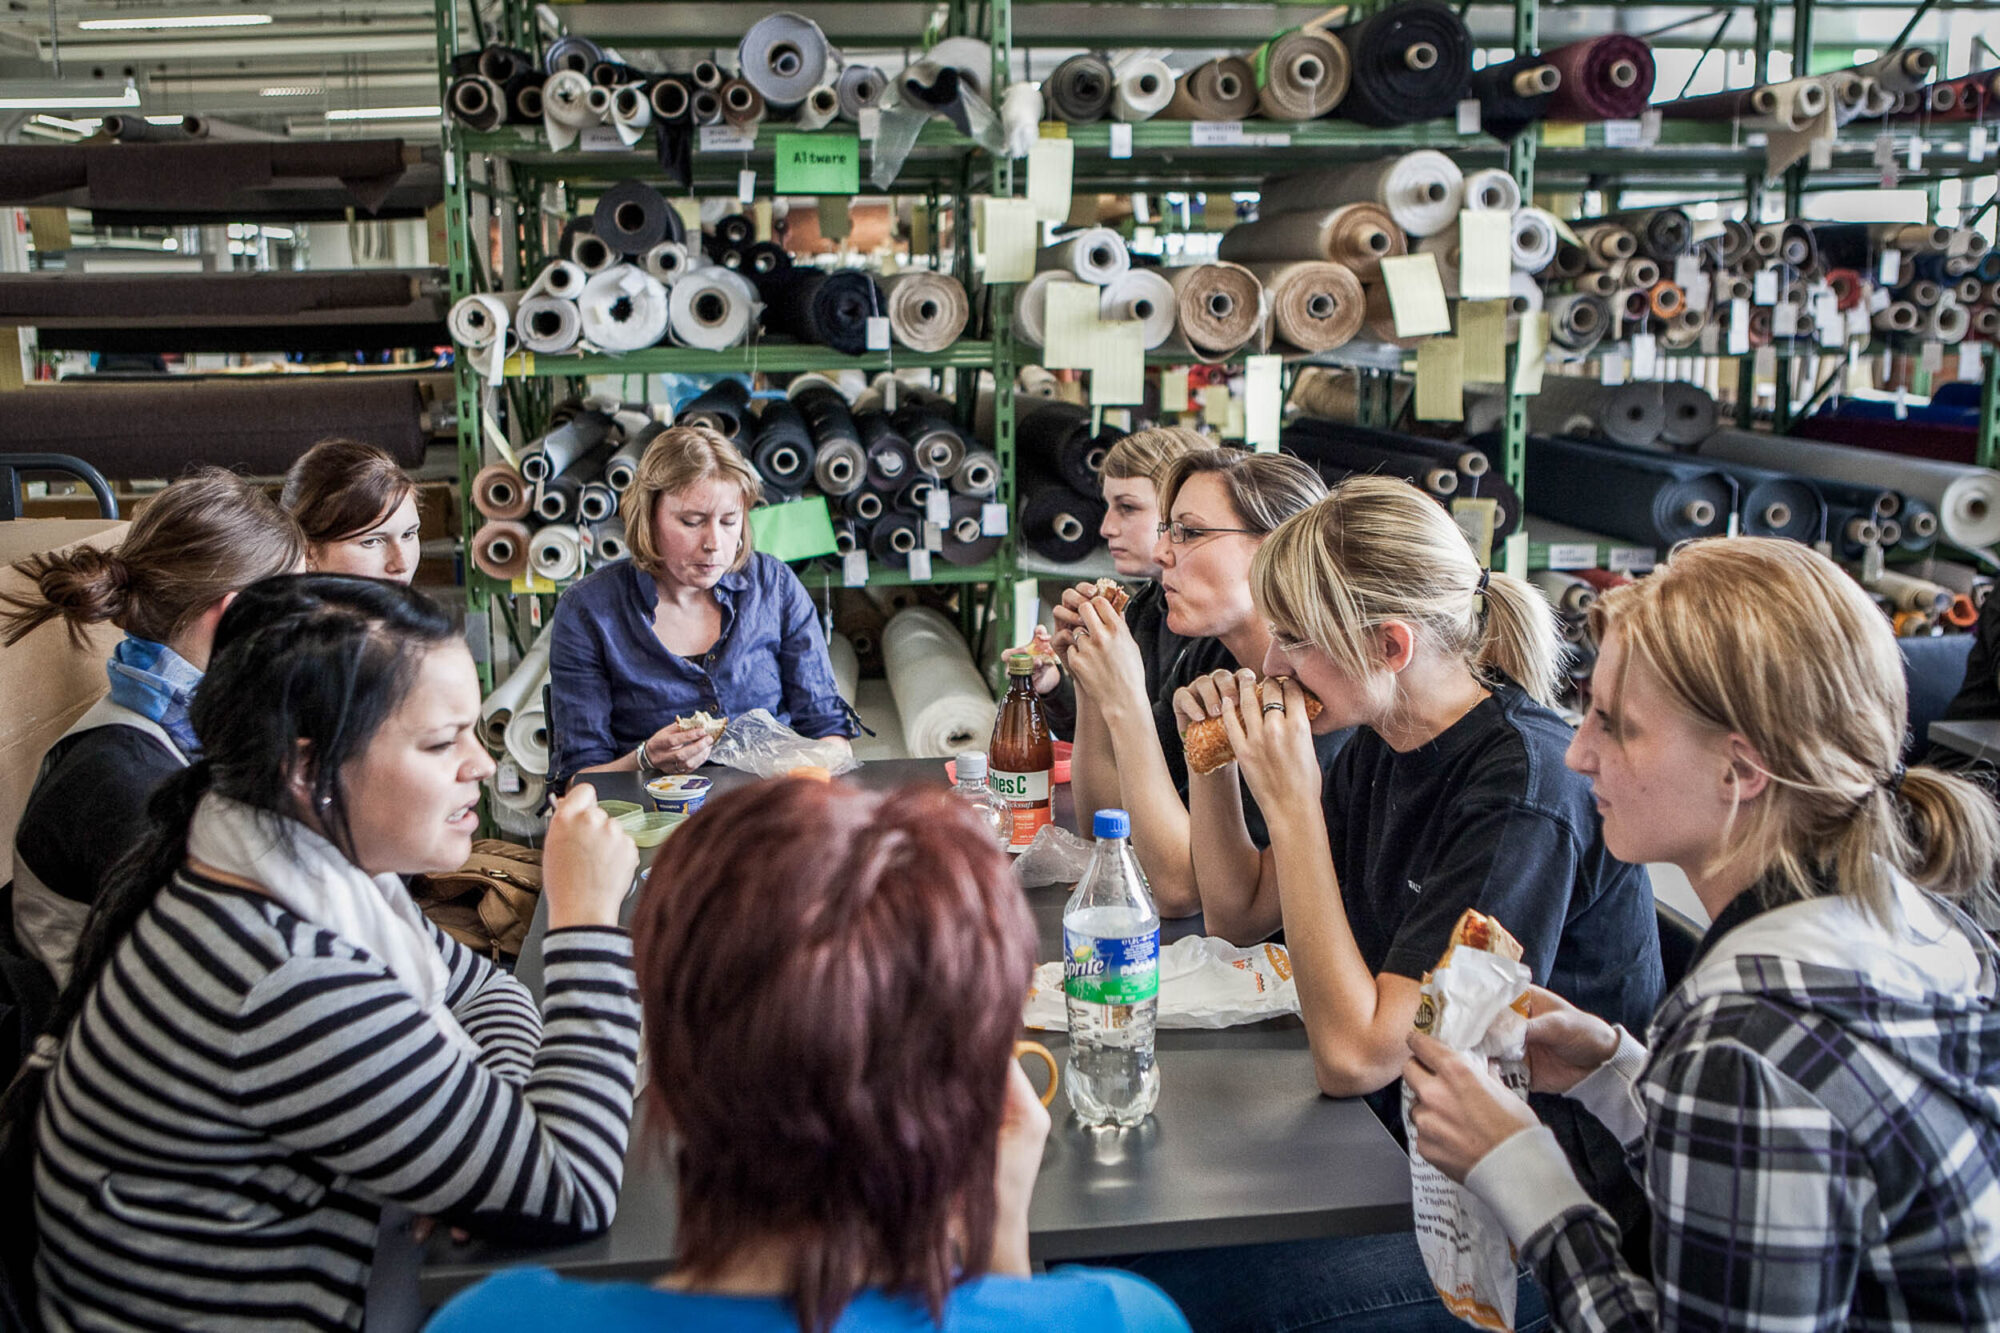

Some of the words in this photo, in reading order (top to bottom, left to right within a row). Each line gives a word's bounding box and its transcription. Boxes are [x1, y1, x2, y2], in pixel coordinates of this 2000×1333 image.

[793, 151, 847, 165] Altware
[1016, 775, 1027, 795] C
[1065, 956, 1105, 980] Sprite
